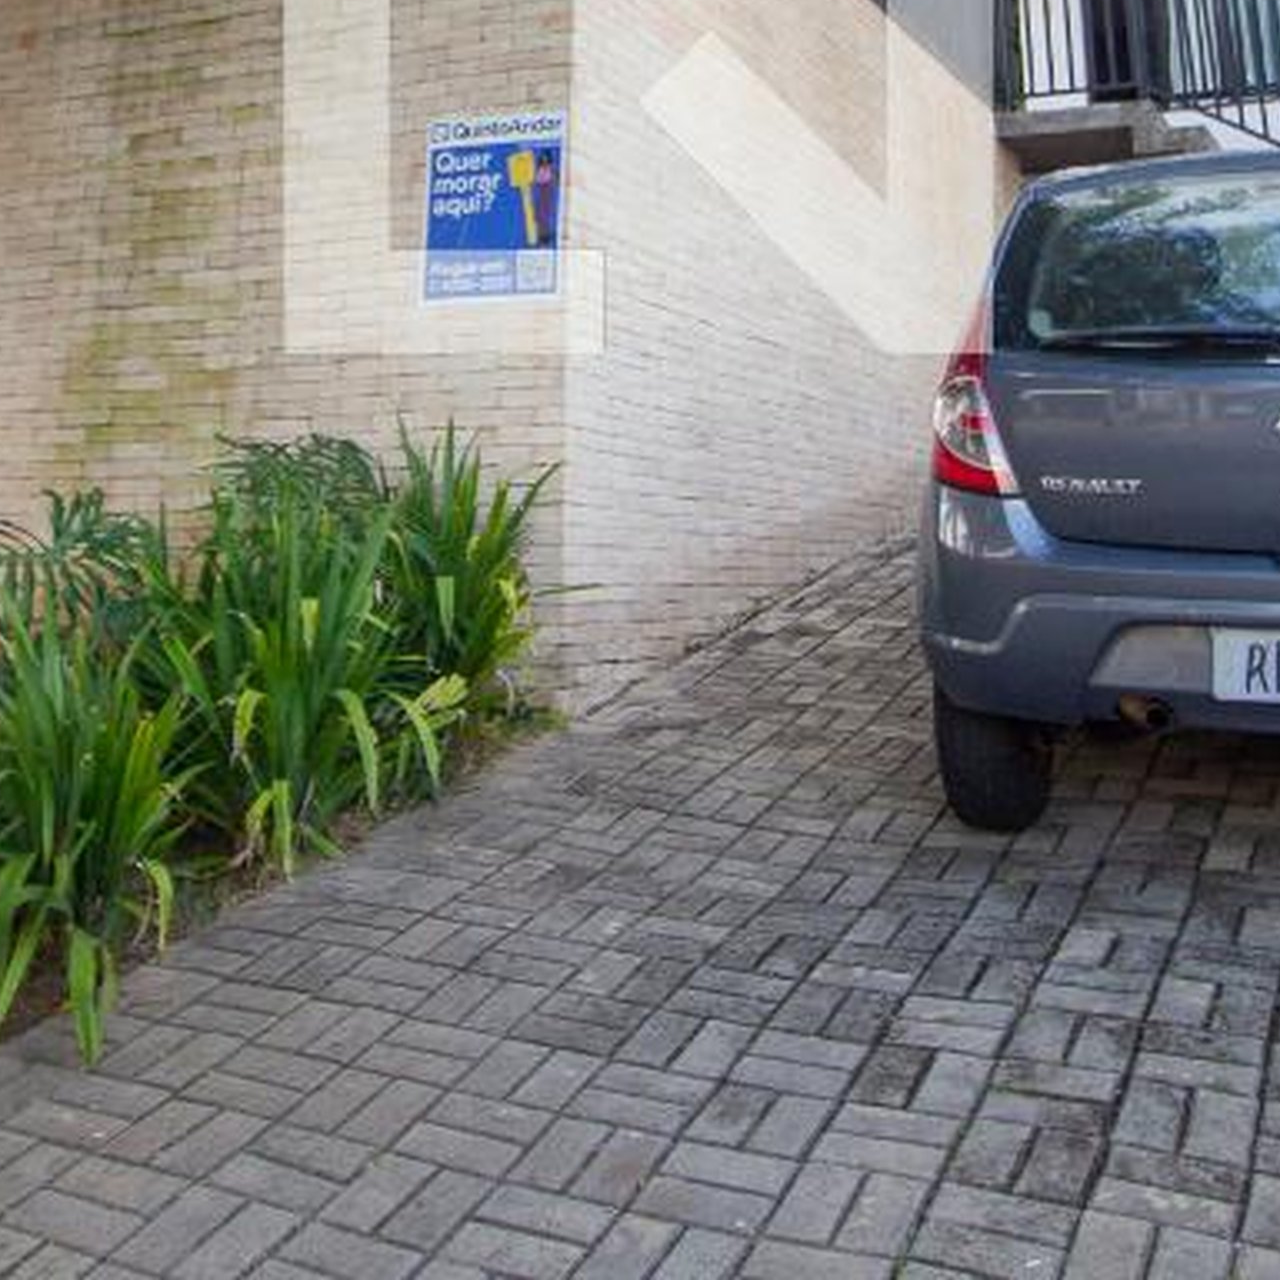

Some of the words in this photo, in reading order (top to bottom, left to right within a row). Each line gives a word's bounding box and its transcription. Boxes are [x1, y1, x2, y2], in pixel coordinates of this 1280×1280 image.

[434, 152, 492, 174] Quer
[433, 174, 502, 195] morar
[432, 191, 496, 220] aqui?
